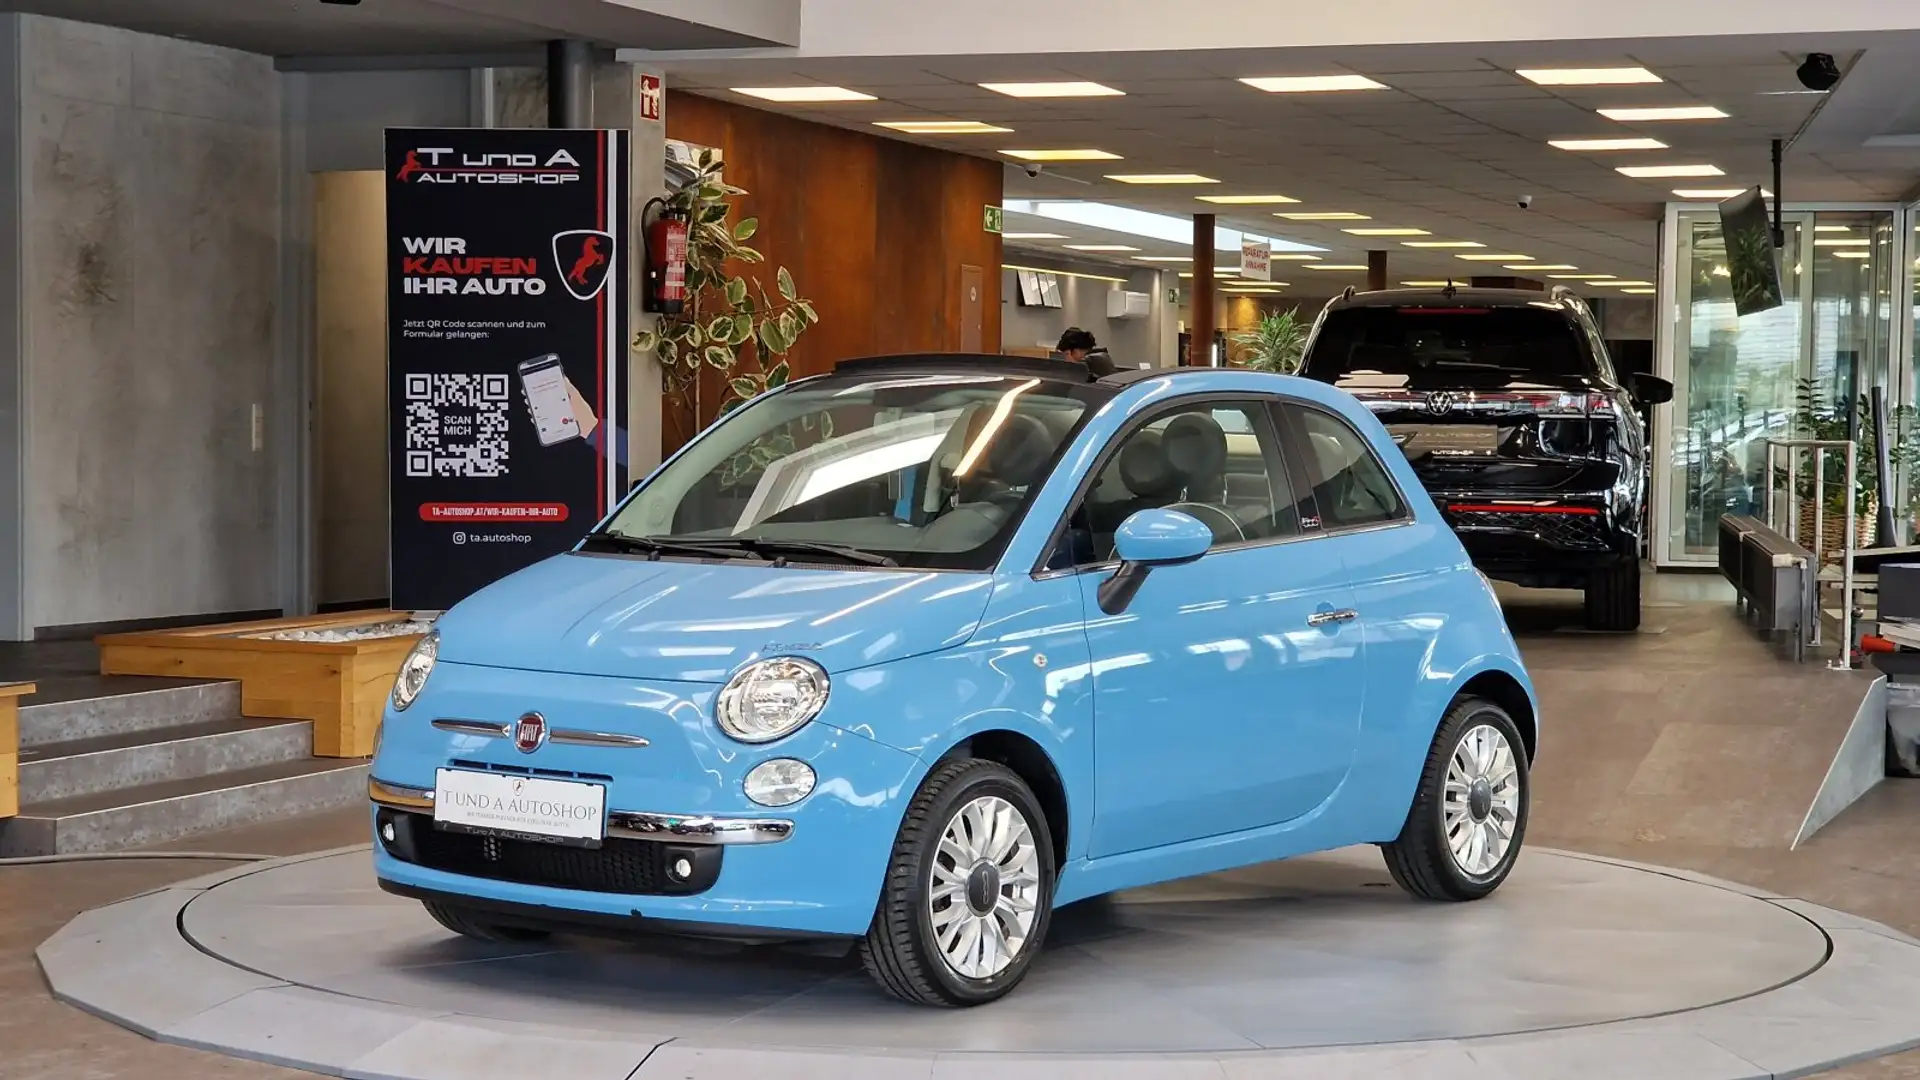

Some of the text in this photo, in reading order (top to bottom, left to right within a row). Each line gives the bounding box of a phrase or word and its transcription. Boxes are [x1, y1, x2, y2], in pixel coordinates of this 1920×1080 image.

[417, 148, 453, 165] T
[544, 149, 580, 167] A
[417, 173, 580, 184] AUTOSHOP
[402, 237, 467, 254] WIR
[403, 257, 537, 275] KAUFEN
[403, 277, 547, 295] IHR AUTO
[403, 320, 425, 328] Jetzt
[427, 320, 441, 329] QR
[442, 320, 466, 328] Code
[506, 320, 525, 328] und
[403, 330, 490, 340] Formular gelangen:
[444, 415, 472, 425] SCAN
[444, 426, 472, 436] MICH
[470, 533, 532, 544] ta.autoshop
[520, 723, 540, 741] FIAT
[443, 790, 453, 804] T
[455, 792, 490, 809] UND
[493, 798, 504, 811] A
[508, 799, 597, 821] AUTOSHOP
[500, 831, 564, 844] AUTOSHOP
